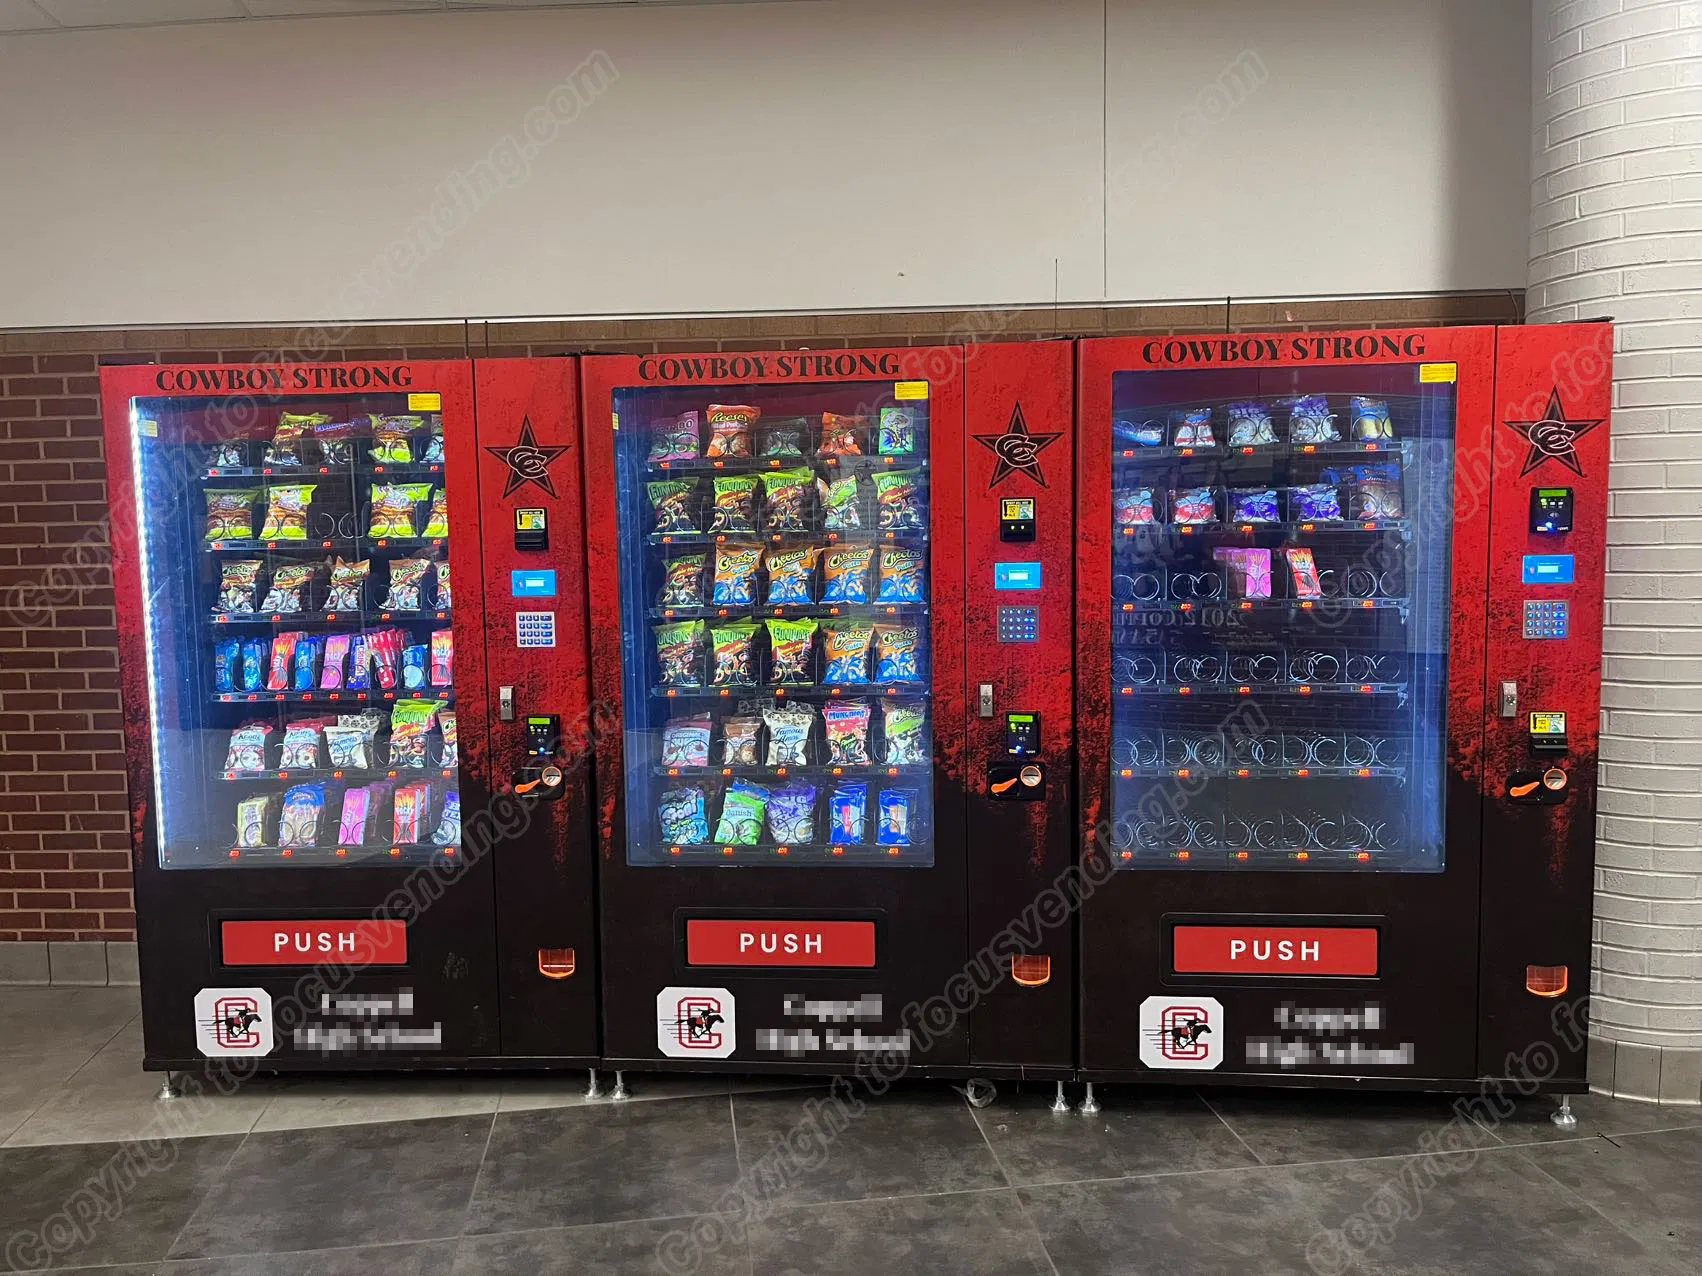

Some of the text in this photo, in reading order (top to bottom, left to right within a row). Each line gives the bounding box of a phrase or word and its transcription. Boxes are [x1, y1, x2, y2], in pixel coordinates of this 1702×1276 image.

[1142, 333, 1427, 365] COWBOY STRONG
[638, 352, 901, 382] COWBOY STRONG
[156, 365, 413, 392] COWBOY STRONG
[718, 551, 757, 572] Cheetos
[769, 550, 807, 571] Cheetos
[829, 551, 869, 569] Cheetos
[882, 628, 919, 646] Cheetos
[273, 932, 357, 954] PUSH
[739, 932, 824, 956] PUSH
[1230, 939, 1321, 962] PUSH
